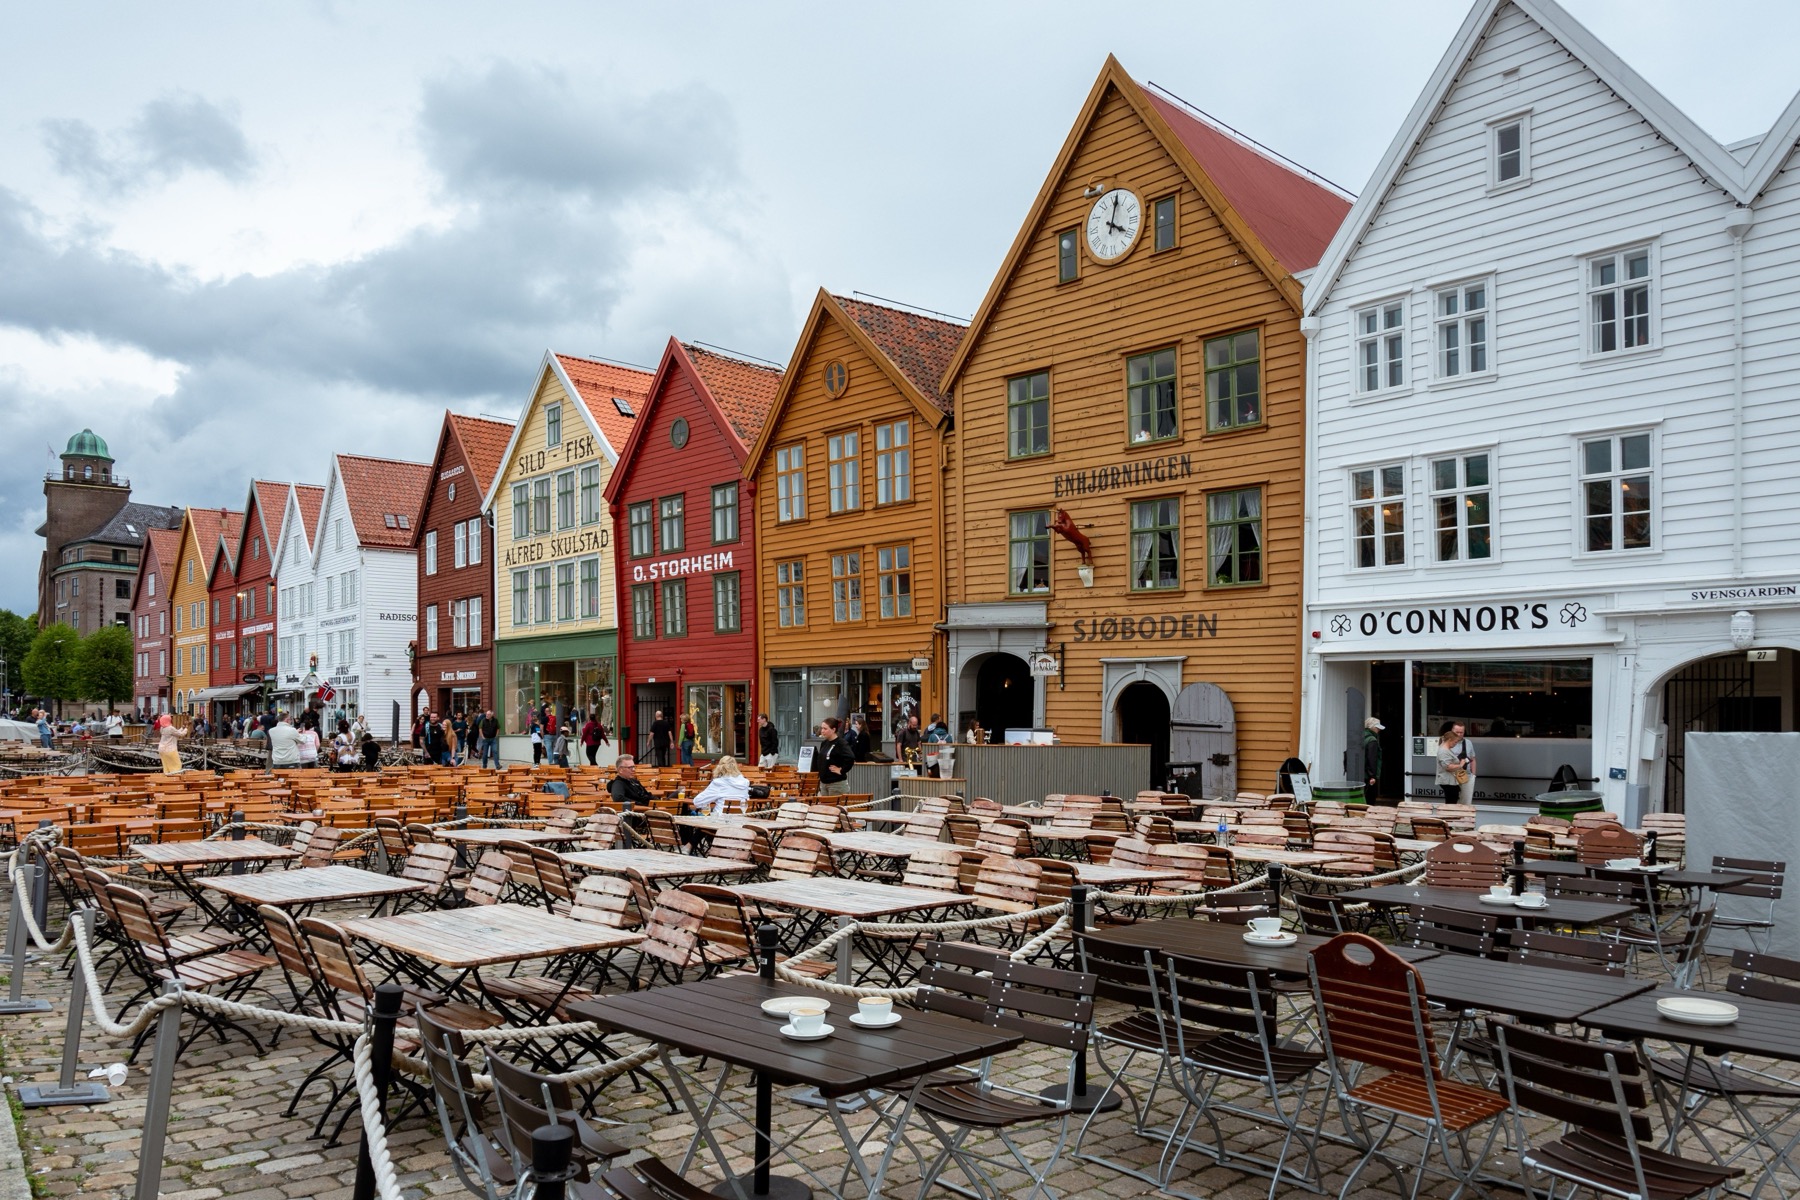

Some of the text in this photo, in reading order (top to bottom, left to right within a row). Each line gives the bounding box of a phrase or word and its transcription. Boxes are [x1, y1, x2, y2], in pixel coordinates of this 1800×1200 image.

[519, 450, 545, 475] SILD
[566, 435, 594, 462] FISK
[1054, 454, 1191, 498] ENHJØRNINGEN
[505, 529, 609, 566] ALFRED SKULSTAD
[649, 551, 733, 579] STORHEIM
[1073, 613, 1218, 643] SJØBODEN
[1359, 603, 1549, 636] O'CONNOR'S
[1756, 651, 1767, 660] 27
[1415, 788, 1436, 796] IRISH
